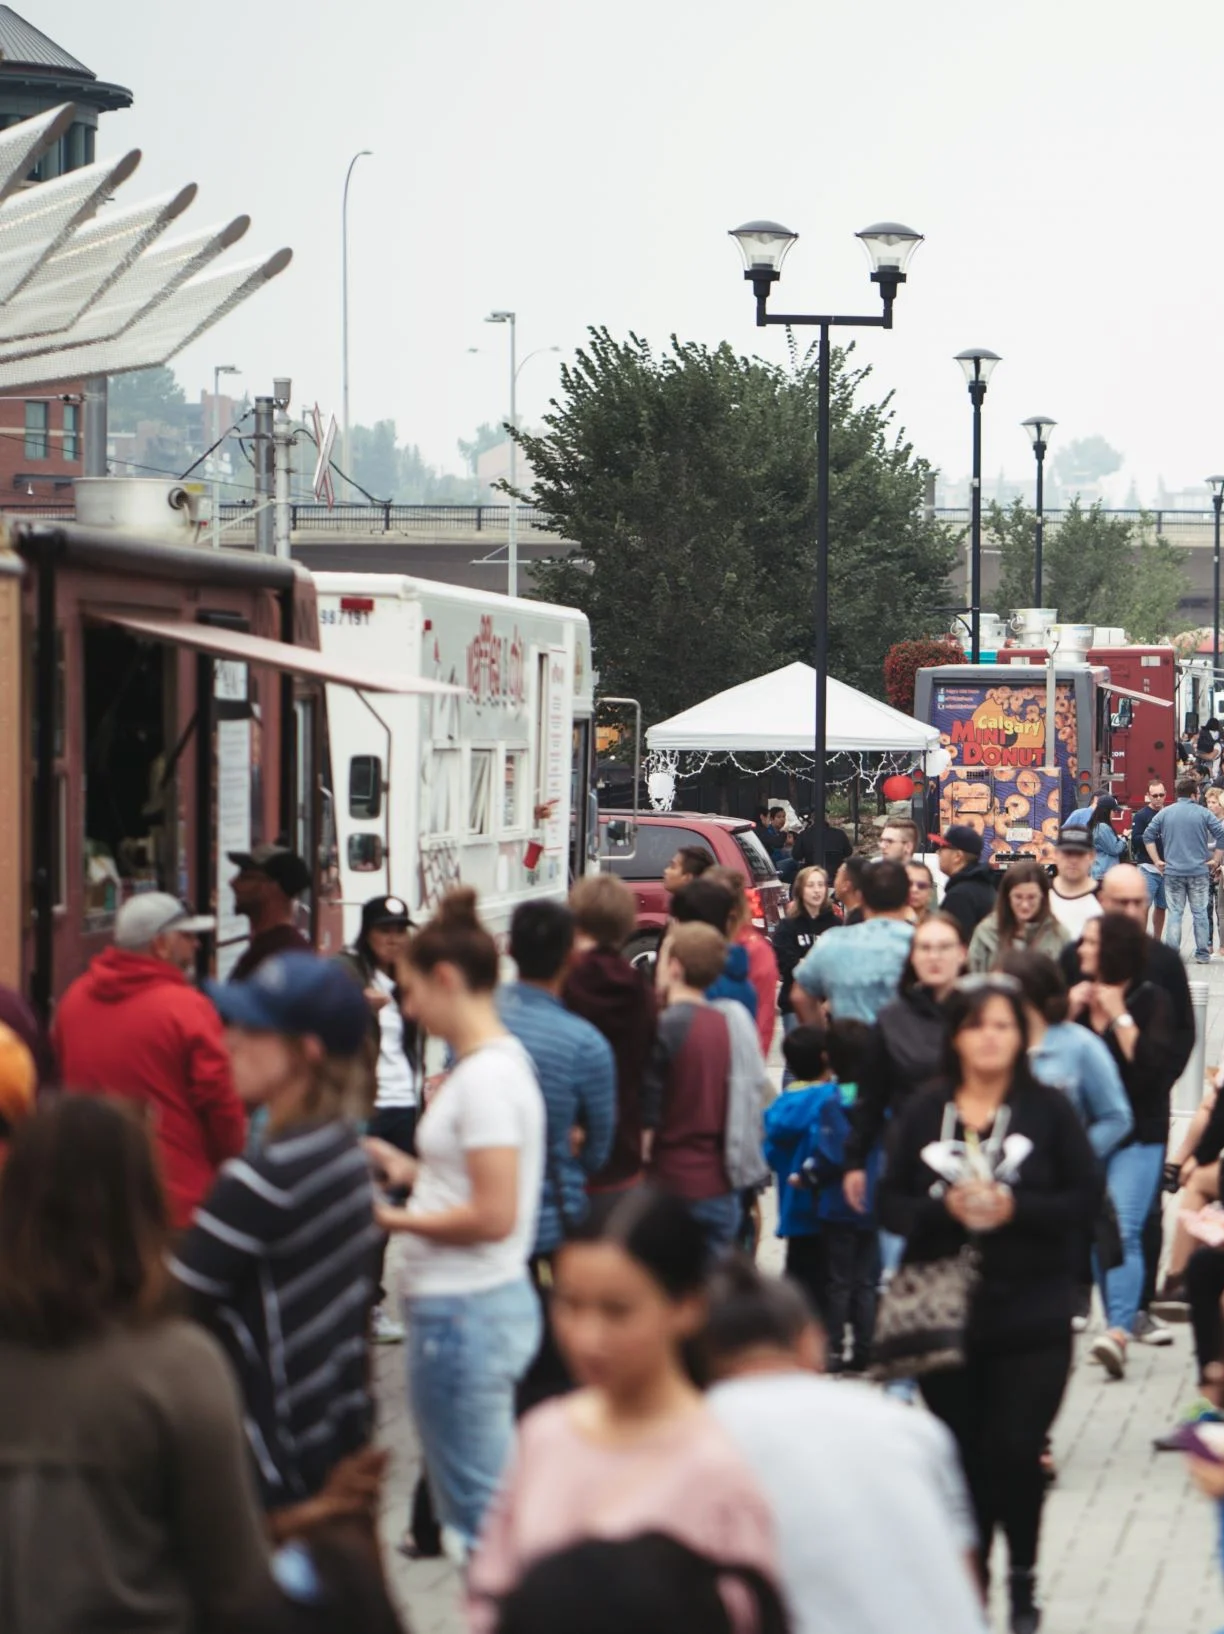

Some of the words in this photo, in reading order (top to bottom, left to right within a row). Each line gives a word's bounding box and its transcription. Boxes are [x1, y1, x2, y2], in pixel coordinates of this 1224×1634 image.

[950, 719, 1007, 745] MINI
[977, 715, 1041, 737] Calgary
[962, 741, 1049, 767] DONUT
